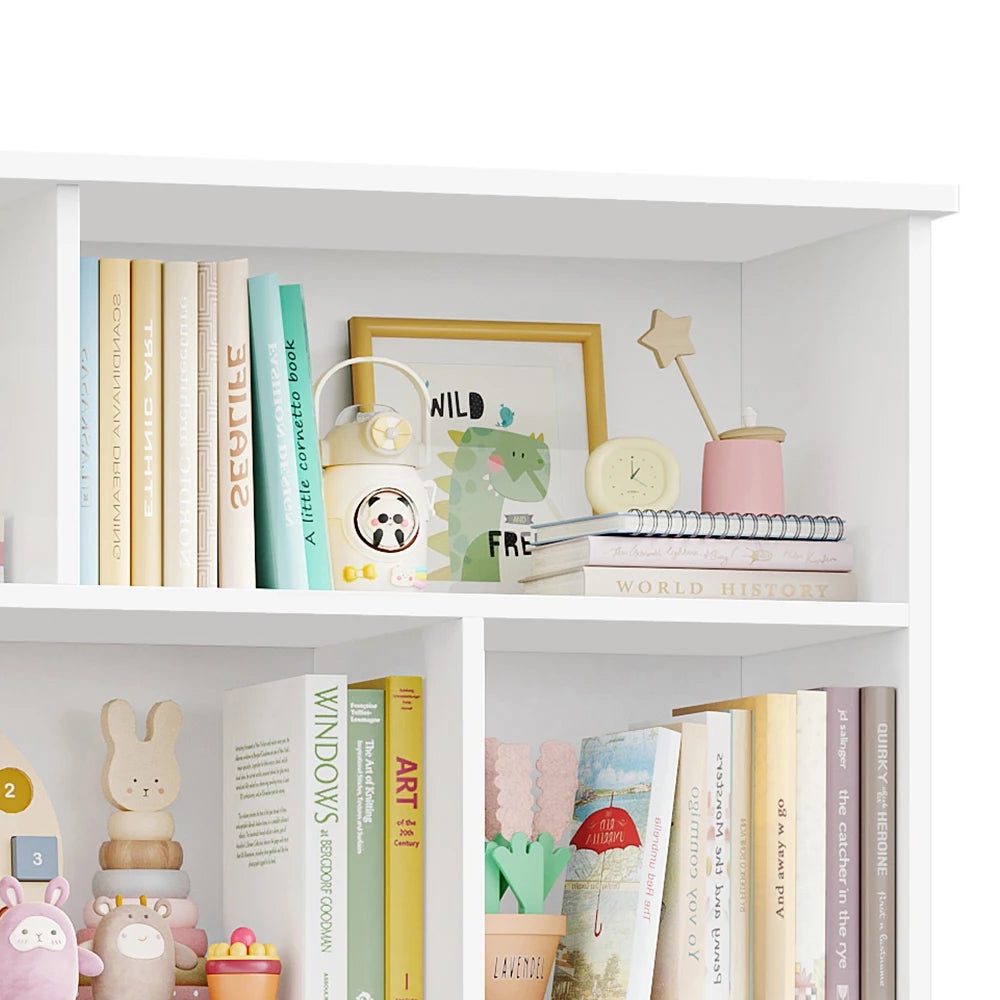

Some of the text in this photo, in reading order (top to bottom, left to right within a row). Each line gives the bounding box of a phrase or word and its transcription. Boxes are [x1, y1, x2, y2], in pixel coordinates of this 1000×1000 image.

[285, 338, 316, 545] A little cornetto book
[488, 530, 538, 558] FRE
[616, 580, 829, 598] WORLD HISTORY
[3, 783, 15, 798] 2
[362, 739, 375, 823] The Art of Knitting
[396, 757, 418, 809] ART
[777, 798, 787, 817] go
[877, 722, 888, 877] QUIRKY HEROINE
[314, 685, 339, 953] WINDOWS at BERGDORF GOODMAN
[397, 818, 417, 827] of the
[399, 828, 414, 837] 20th
[394, 838, 420, 849] Century
[835, 708, 849, 969] jd salinger the catcher in the rye
[32, 852, 43, 866] 3
[777, 841, 787, 880] away
[775, 885, 785, 919] And
[493, 956, 545, 979] LAVENDEL
